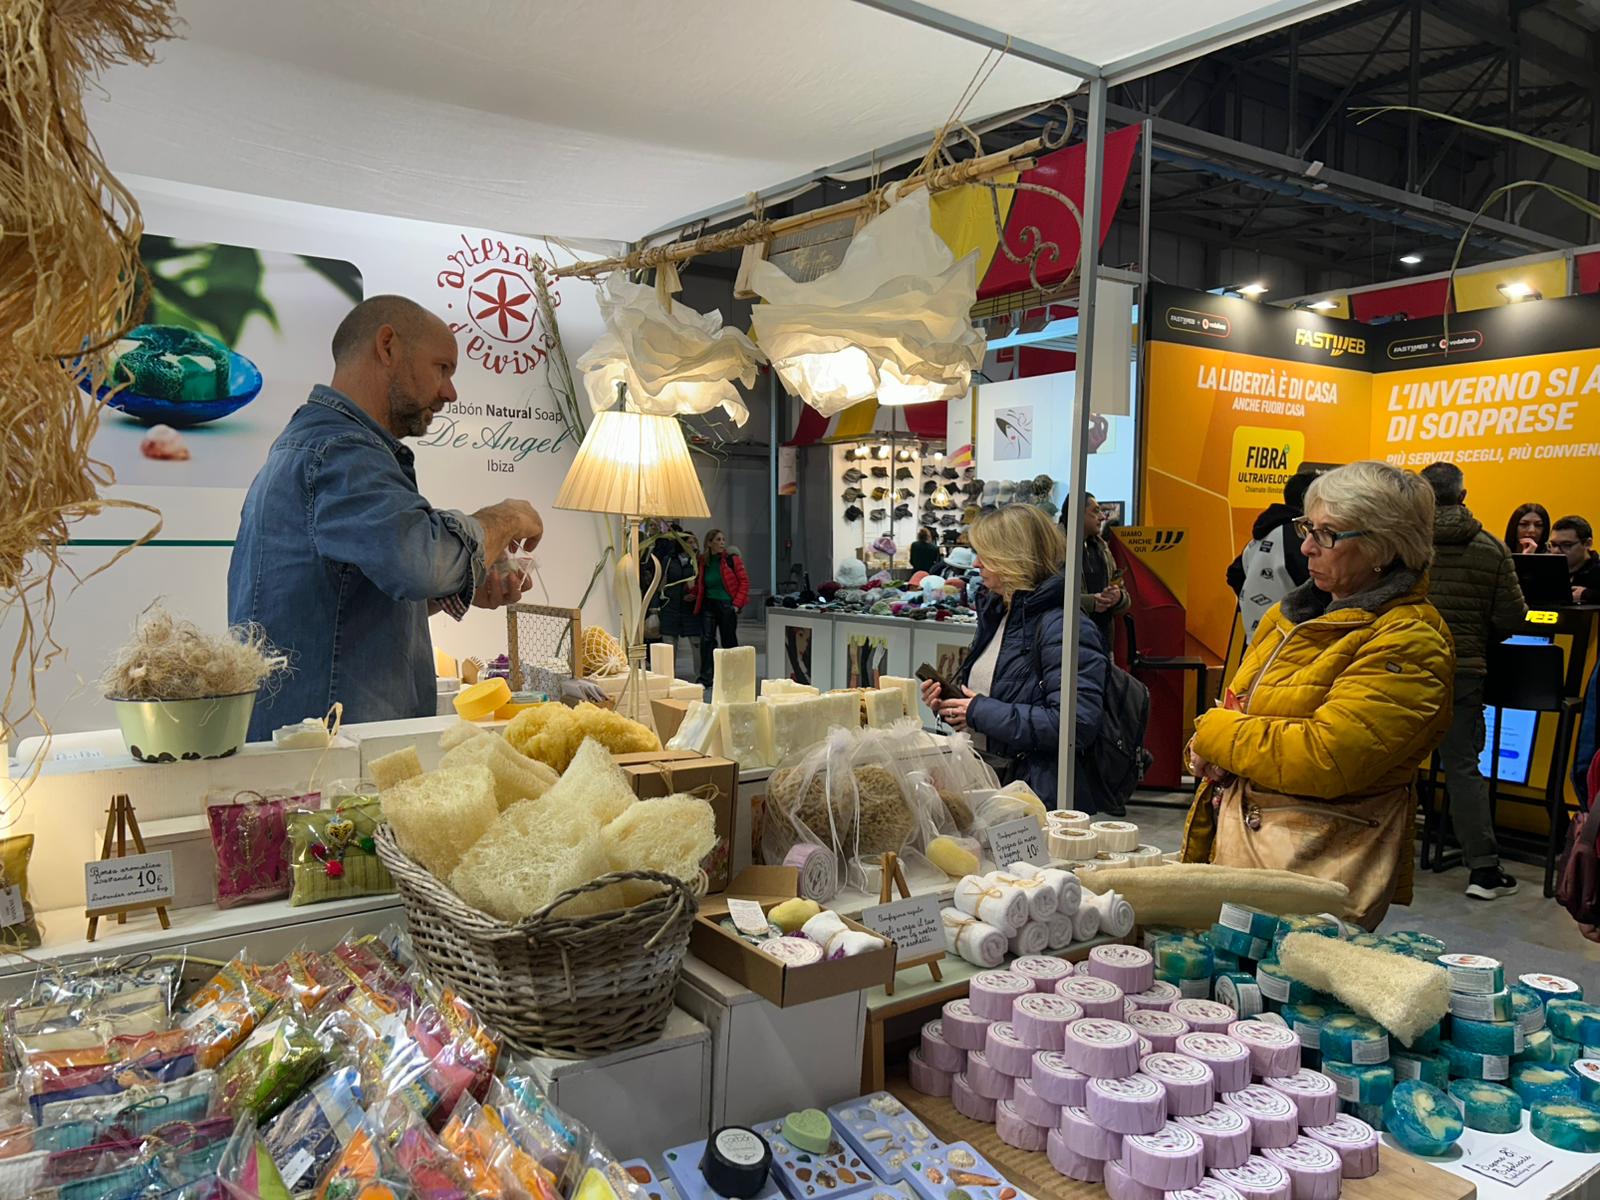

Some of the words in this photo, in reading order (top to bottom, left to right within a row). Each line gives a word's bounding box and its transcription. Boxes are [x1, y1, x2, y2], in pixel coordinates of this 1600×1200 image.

[1295, 327, 1366, 357] FASTWEB
[1197, 365, 1217, 389] LA
[1219, 366, 1276, 397] LIBERTÀ
[1278, 370, 1289, 399] È
[1290, 377, 1303, 400] DI
[1305, 380, 1338, 404] CASA
[1387, 371, 1541, 412] L'INVERNO
[1544, 366, 1581, 398] SI
[446, 401, 483, 416] Jabón
[486, 402, 532, 419] Natural
[535, 407, 563, 422] Soap
[1232, 397, 1260, 413] ANCHE
[1261, 400, 1285, 415] FUORI
[1285, 402, 1305, 417] CASA
[1386, 414, 1417, 442] DI
[1419, 401, 1579, 441] SORPRESE
[417, 415, 469, 449] De
[473, 421, 576, 462] Angel
[487, 459, 515, 473] Ibiza
[1245, 445, 1288, 470] FIBRA
[1408, 450, 1455, 466] SERVIZI
[1456, 448, 1504, 464] SCEGLI,
[1508, 443, 1532, 460] PIÙ
